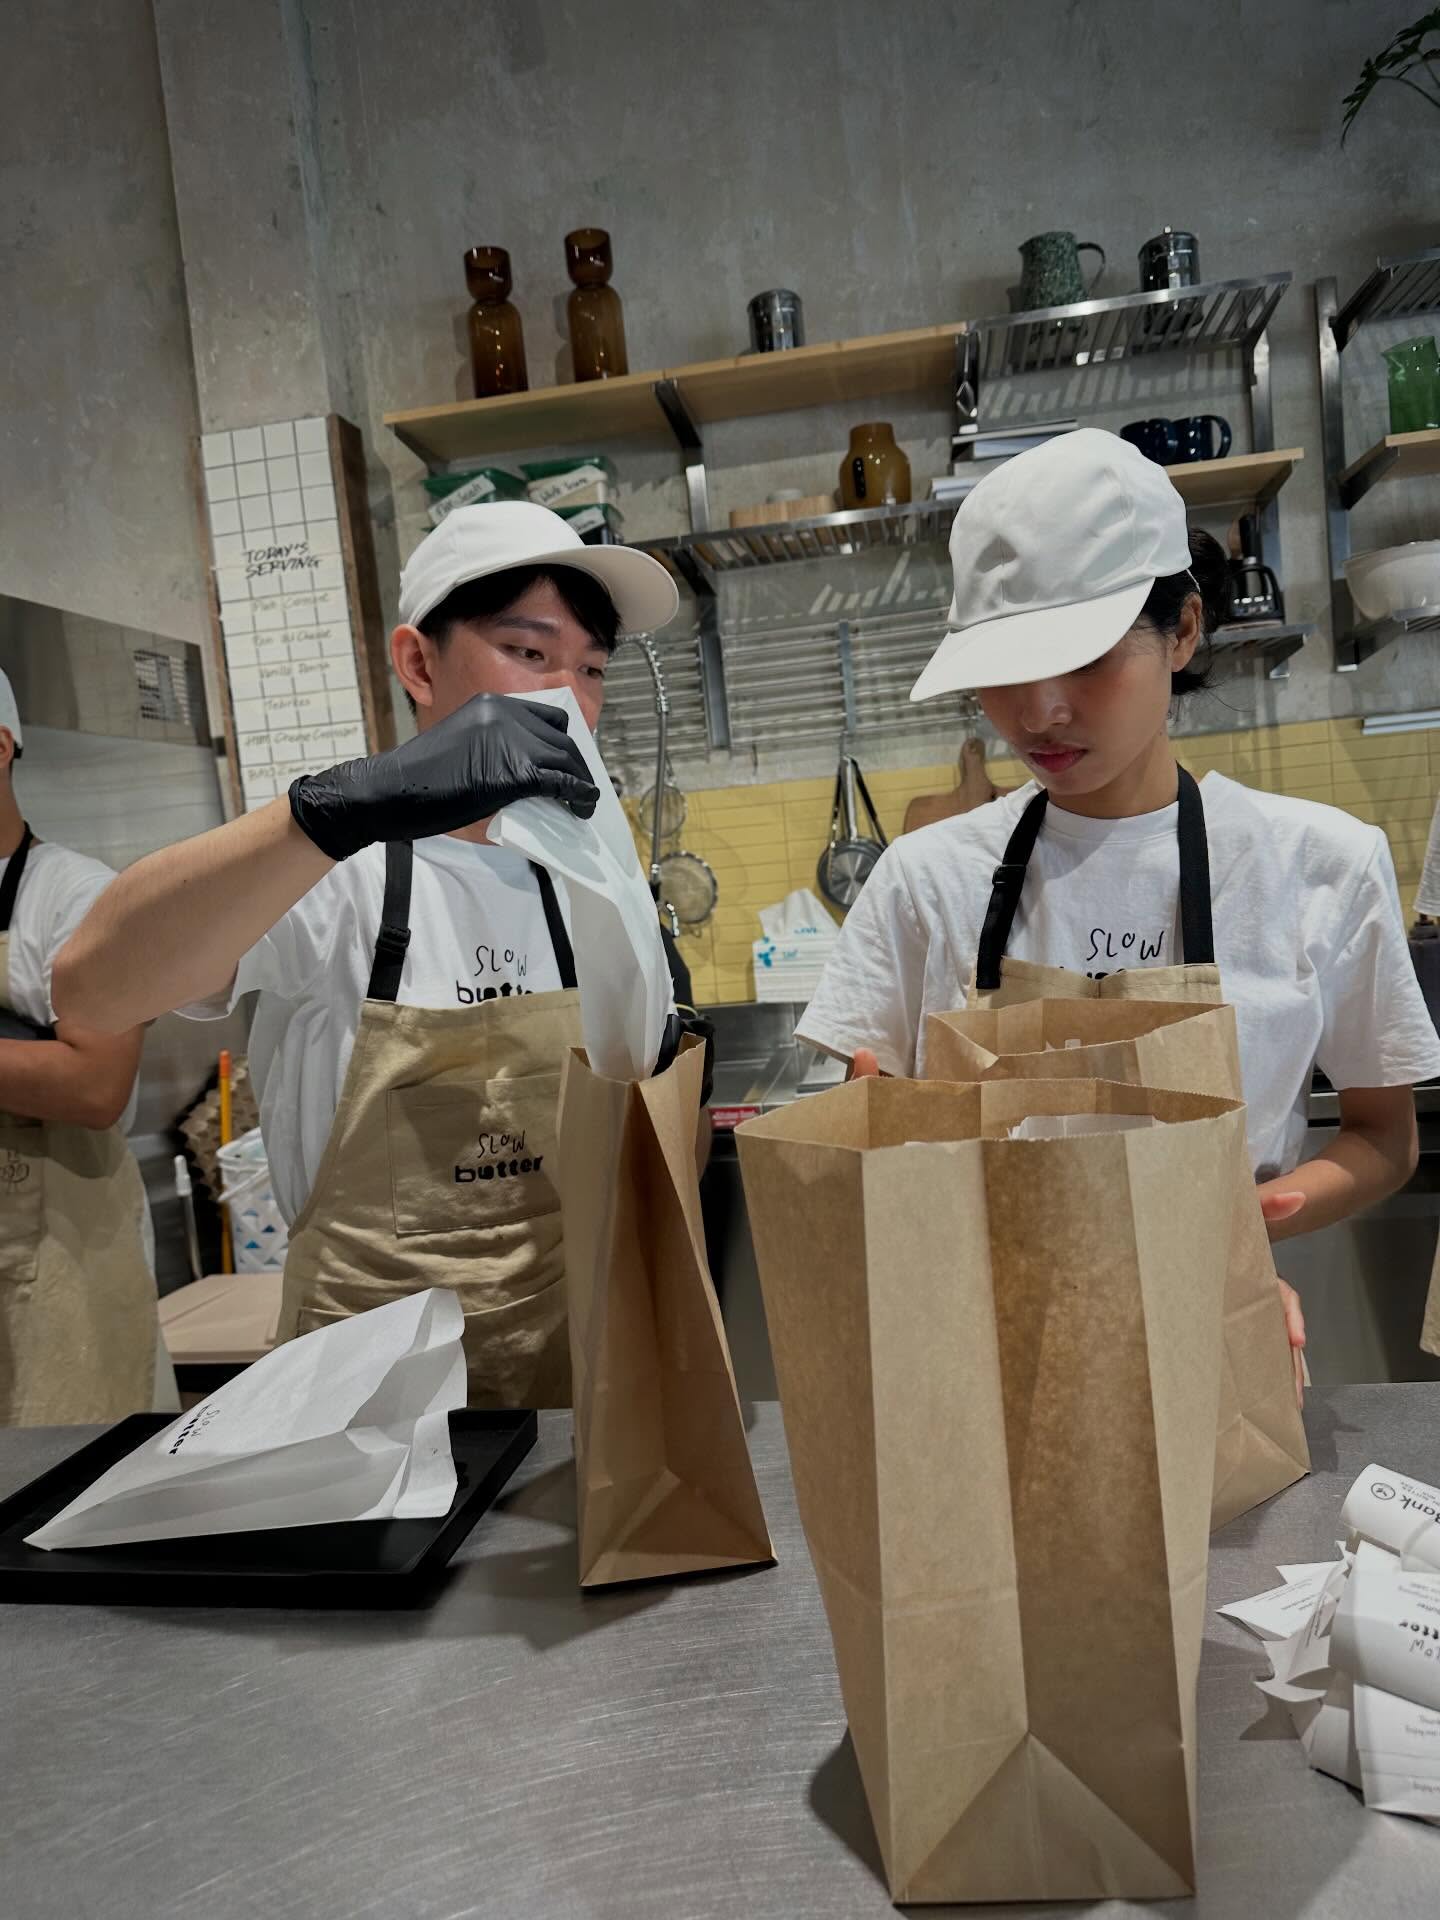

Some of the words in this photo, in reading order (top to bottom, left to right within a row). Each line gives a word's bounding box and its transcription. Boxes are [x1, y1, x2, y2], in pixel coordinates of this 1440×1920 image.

[242, 541, 310, 564] TODAY'S
[245, 556, 322, 579] SERVING
[1086, 928, 1165, 961] SLOW
[474, 945, 527, 976] SLOW
[477, 1131, 525, 1158] SLOW
[455, 1155, 544, 1183] butter
[168, 1403, 213, 1455] butter
[1399, 1621, 1440, 1640] tter
